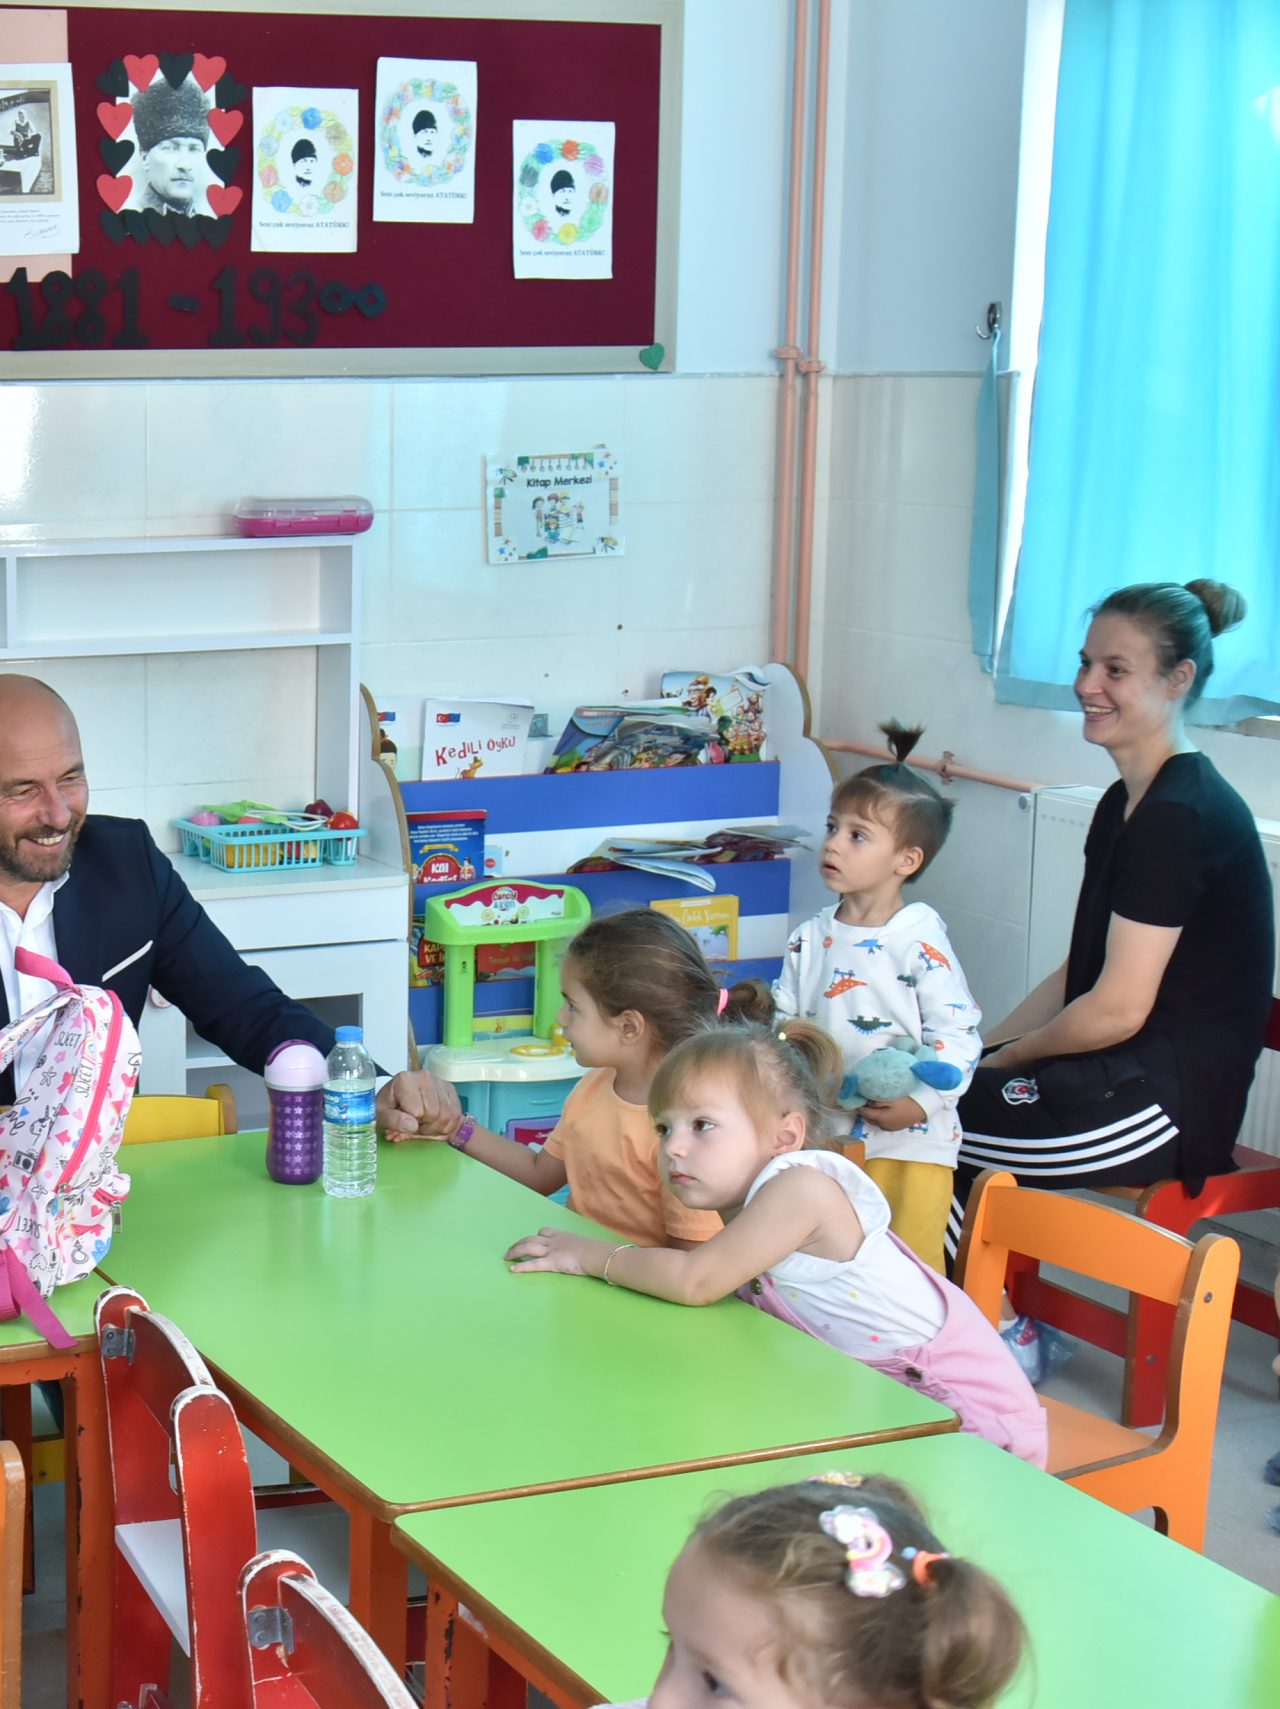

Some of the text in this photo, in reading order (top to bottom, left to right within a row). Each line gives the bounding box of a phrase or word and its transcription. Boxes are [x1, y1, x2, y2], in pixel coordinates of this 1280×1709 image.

[4, 266, 150, 351] 1881
[526, 474, 592, 488] Kitap Merkezi
[75, 1063, 93, 1098] SWEET
